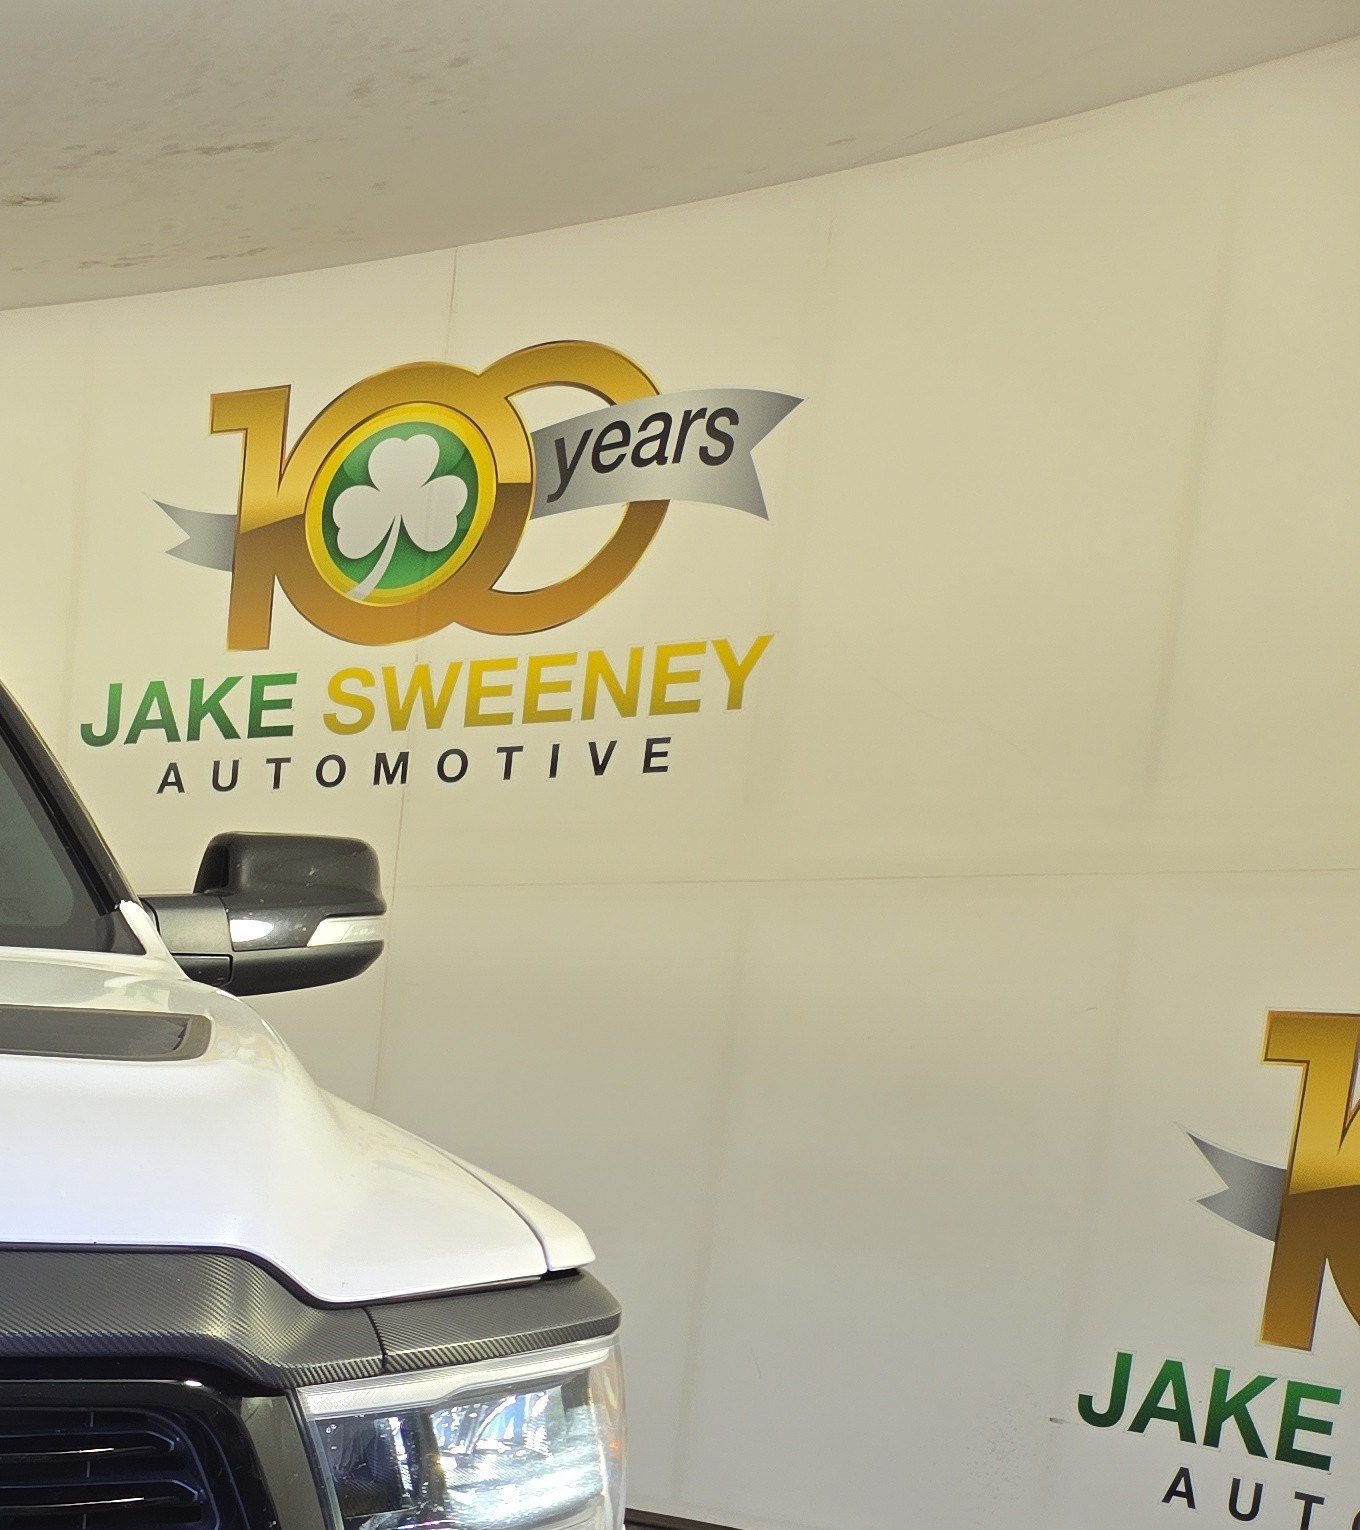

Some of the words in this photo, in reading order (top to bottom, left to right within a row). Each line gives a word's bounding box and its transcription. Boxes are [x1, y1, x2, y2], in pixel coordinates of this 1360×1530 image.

[547, 405, 739, 503] years
[81, 671, 298, 748] JAKE
[322, 634, 774, 736] SWEENEY
[157, 737, 672, 795] AUTOMOTIVE
[1077, 1351, 1342, 1472] JAKE
